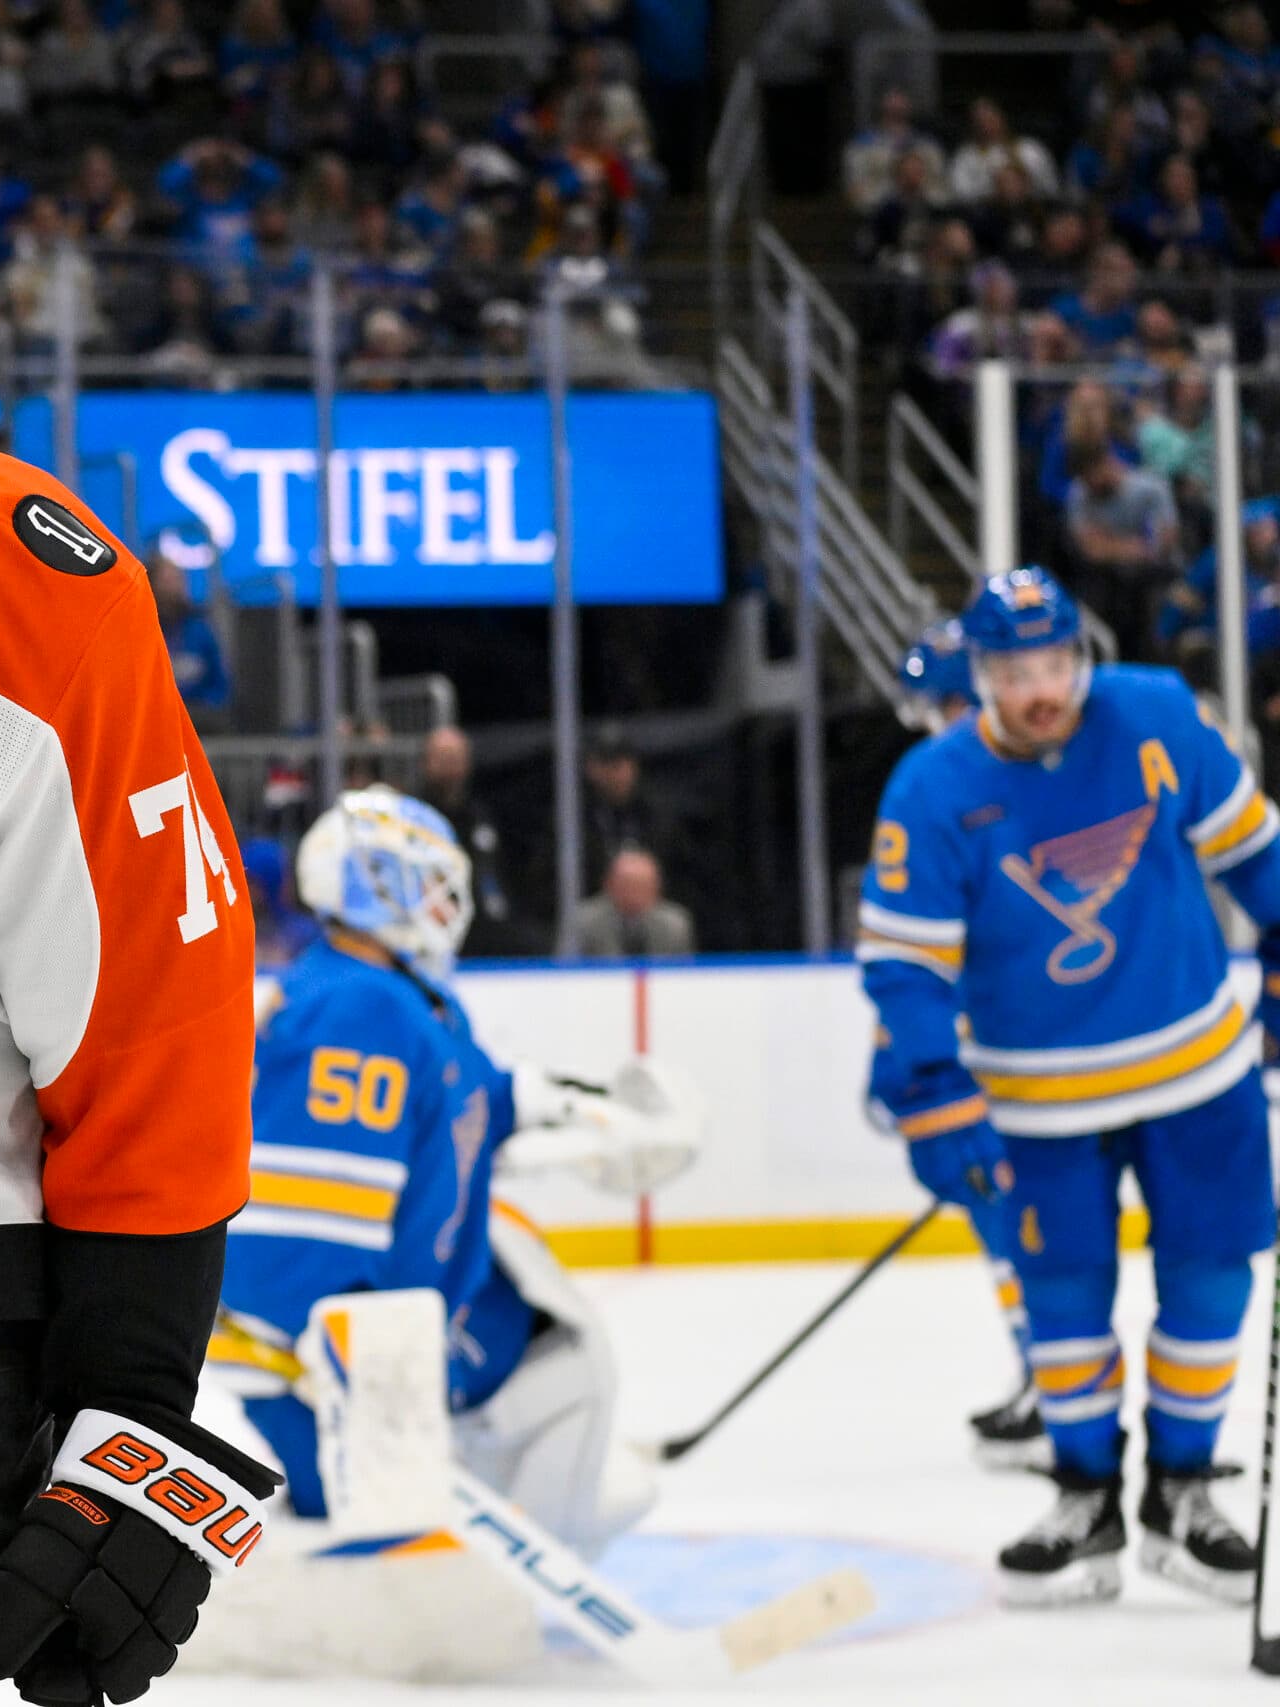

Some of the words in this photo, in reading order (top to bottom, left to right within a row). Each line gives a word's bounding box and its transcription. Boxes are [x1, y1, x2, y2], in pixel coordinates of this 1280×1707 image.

[27, 504, 104, 564] 1
[161, 428, 557, 569] STIFEL
[1139, 738, 1179, 801] A
[307, 1046, 409, 1132] 50
[73, 1498, 101, 1520] SERIES
[80, 1432, 262, 1567] BAU
